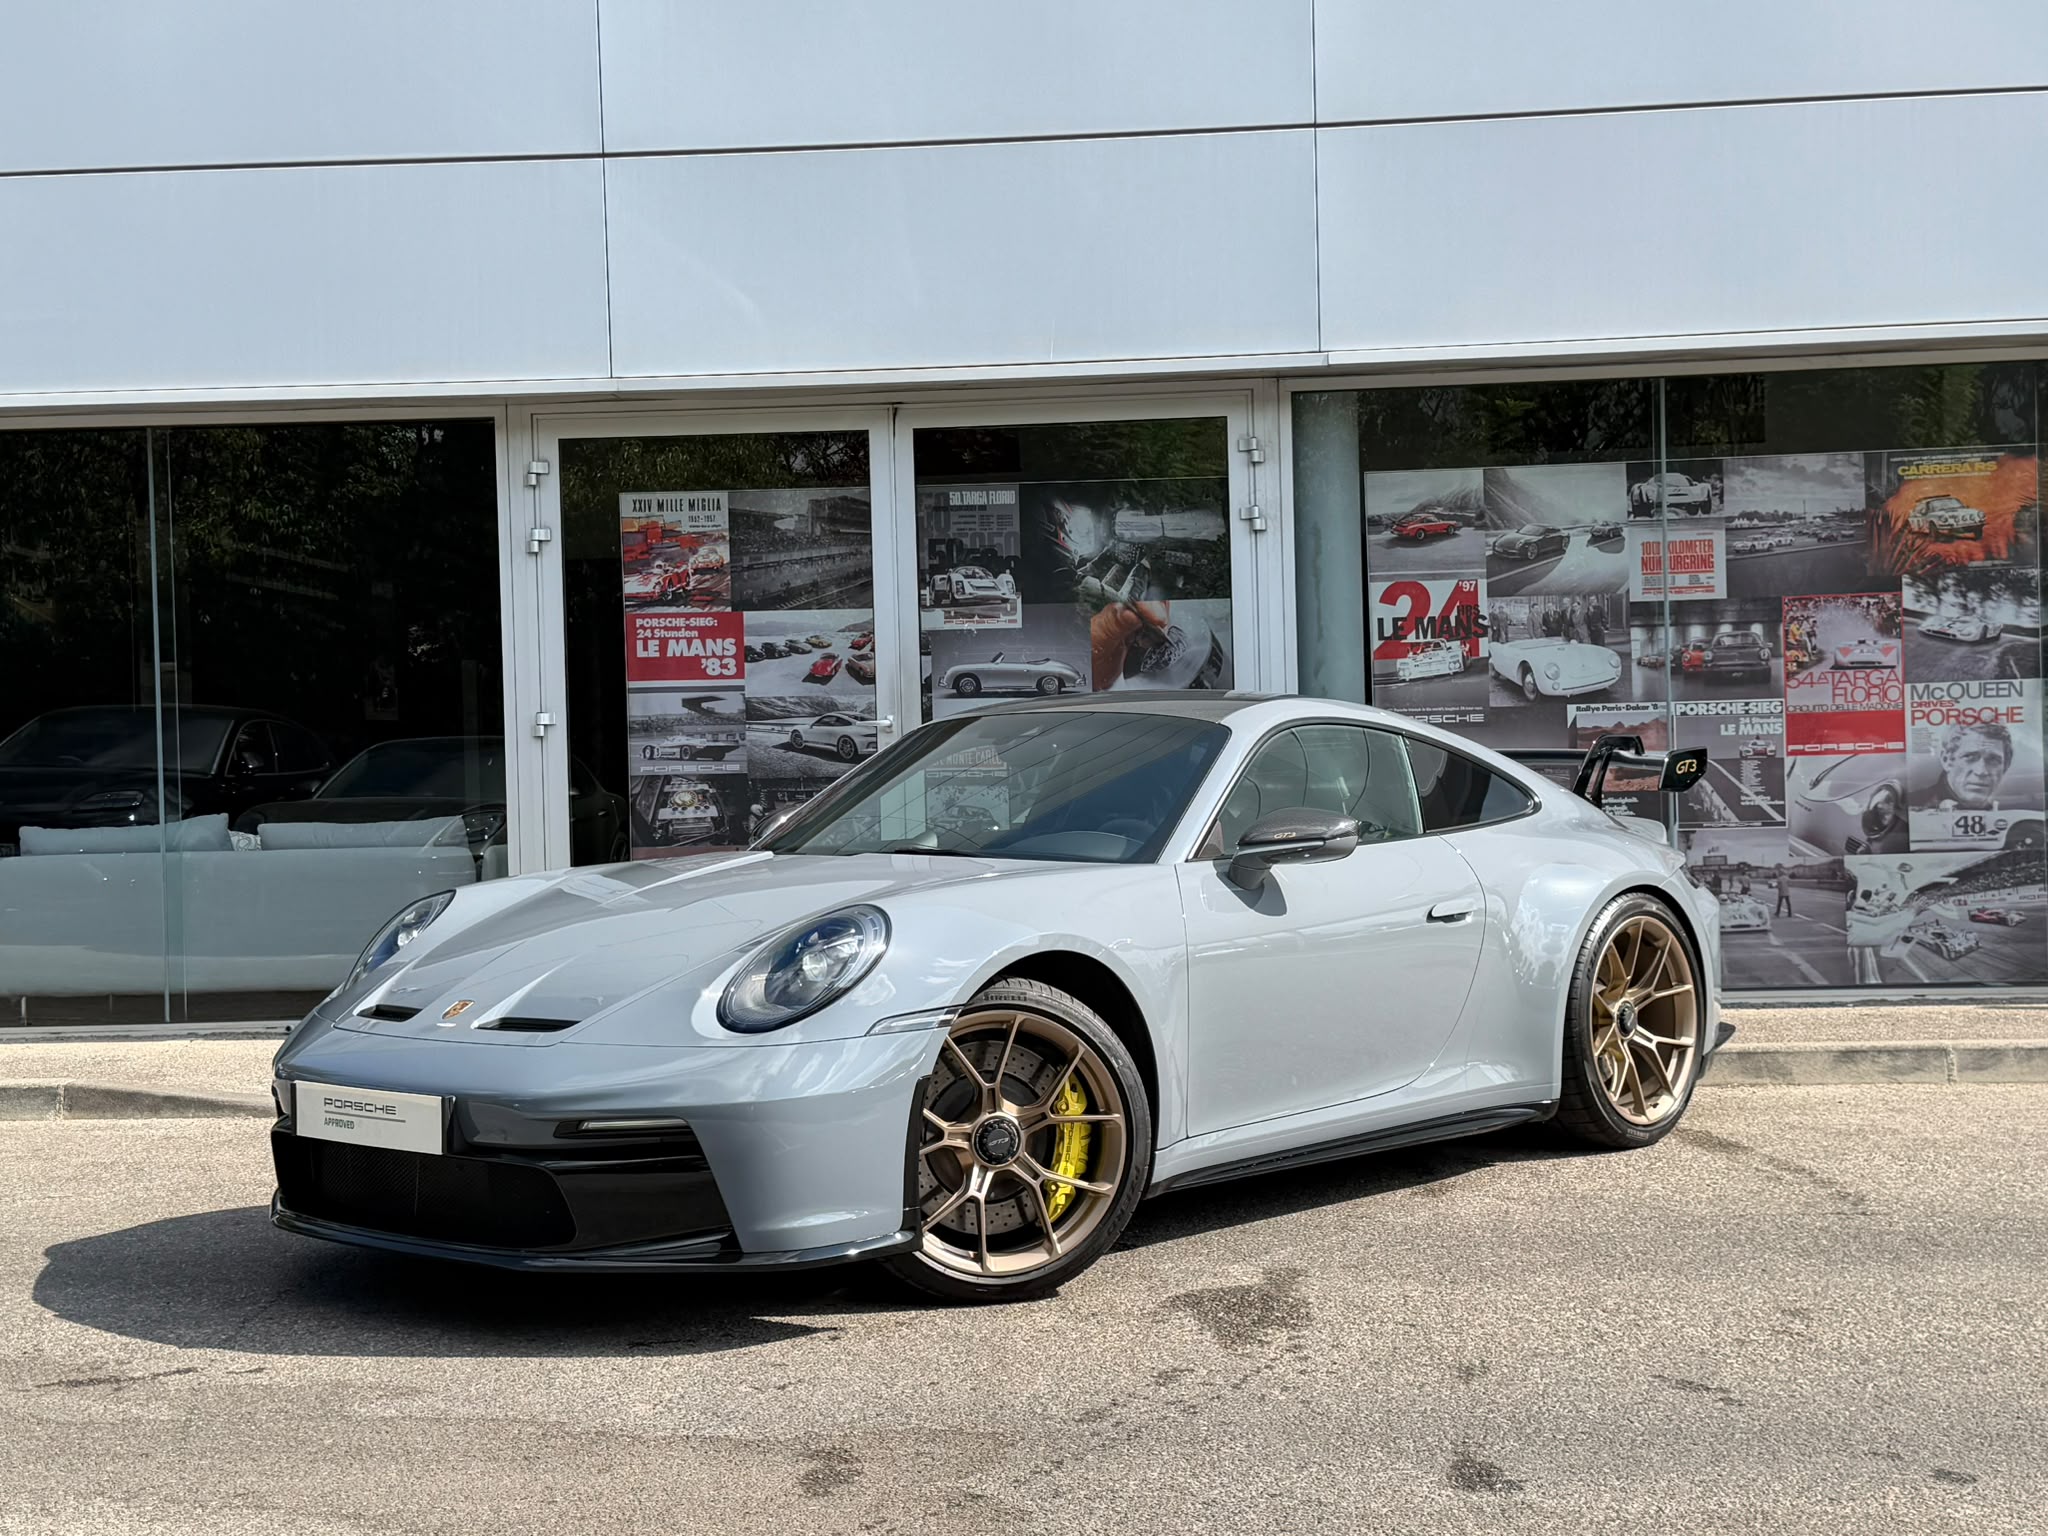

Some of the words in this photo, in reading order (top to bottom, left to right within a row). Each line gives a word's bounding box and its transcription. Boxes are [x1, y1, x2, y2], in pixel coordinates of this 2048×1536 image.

[1898, 463, 1972, 476] CARRERA
[1974, 461, 1998, 472] RS
[988, 490, 1016, 505] FLORIO
[632, 499, 653, 513] XXIV
[657, 498, 684, 513] MILLE
[688, 498, 722, 512] MIGLIA
[1458, 580, 1477, 592] '97
[635, 617, 719, 628] PORSCHE-SIEG:
[1373, 579, 1480, 661] 24
[1377, 617, 1408, 641] LE
[1414, 614, 1489, 641] MANS
[636, 629, 652, 638] 24
[654, 628, 699, 638] Stunden
[636, 639, 660, 658] LE
[666, 637, 737, 657] MANS
[701, 657, 738, 676] '83
[1826, 669, 1901, 687] TARGA
[1832, 684, 1901, 704] FLORIO
[1910, 681, 2024, 704] McQUEEN
[1576, 705, 1601, 713] Rallye
[1676, 702, 1783, 716] PORSCHE-SIEG
[1910, 700, 1955, 709] DRIVES
[1911, 706, 2025, 727] PORSCHE
[1720, 724, 1736, 736] LE
[1739, 723, 1783, 735] MANS
[1787, 742, 1905, 752] PORSCHE
[640, 763, 740, 773] PORSCHE
[1675, 759, 1697, 775] GT3
[1954, 815, 1985, 835] 48
[1273, 831, 1297, 839] GT3
[324, 1097, 397, 1116] PORSCHE
[323, 1117, 355, 1130] APPROVED
